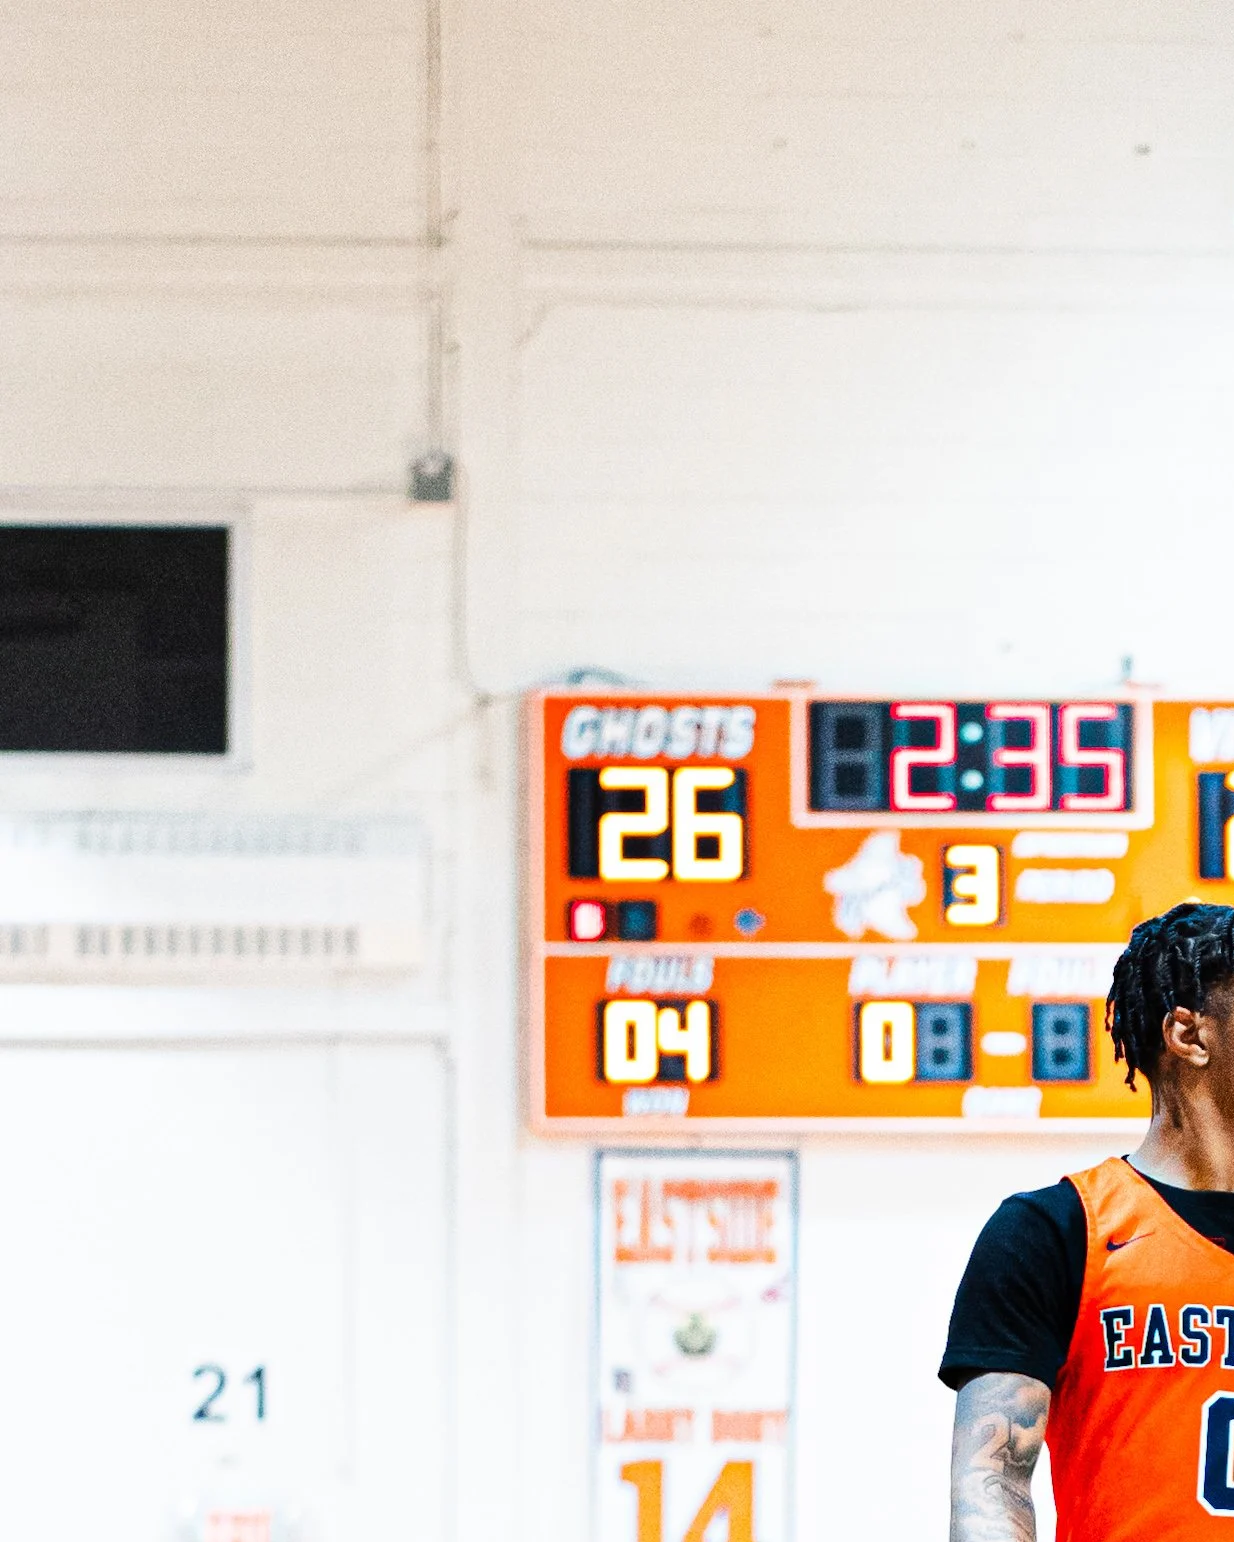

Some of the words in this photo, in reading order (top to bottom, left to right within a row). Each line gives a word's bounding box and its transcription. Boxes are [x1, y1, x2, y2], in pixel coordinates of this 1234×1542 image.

[562, 705, 756, 760] GHOSTS
[889, 701, 1125, 812] 2:35
[599, 766, 744, 882] 26
[944, 844, 999, 926] 3
[604, 999, 711, 1084] 04
[861, 1000, 915, 1084] 0
[190, 1364, 269, 1422] 21
